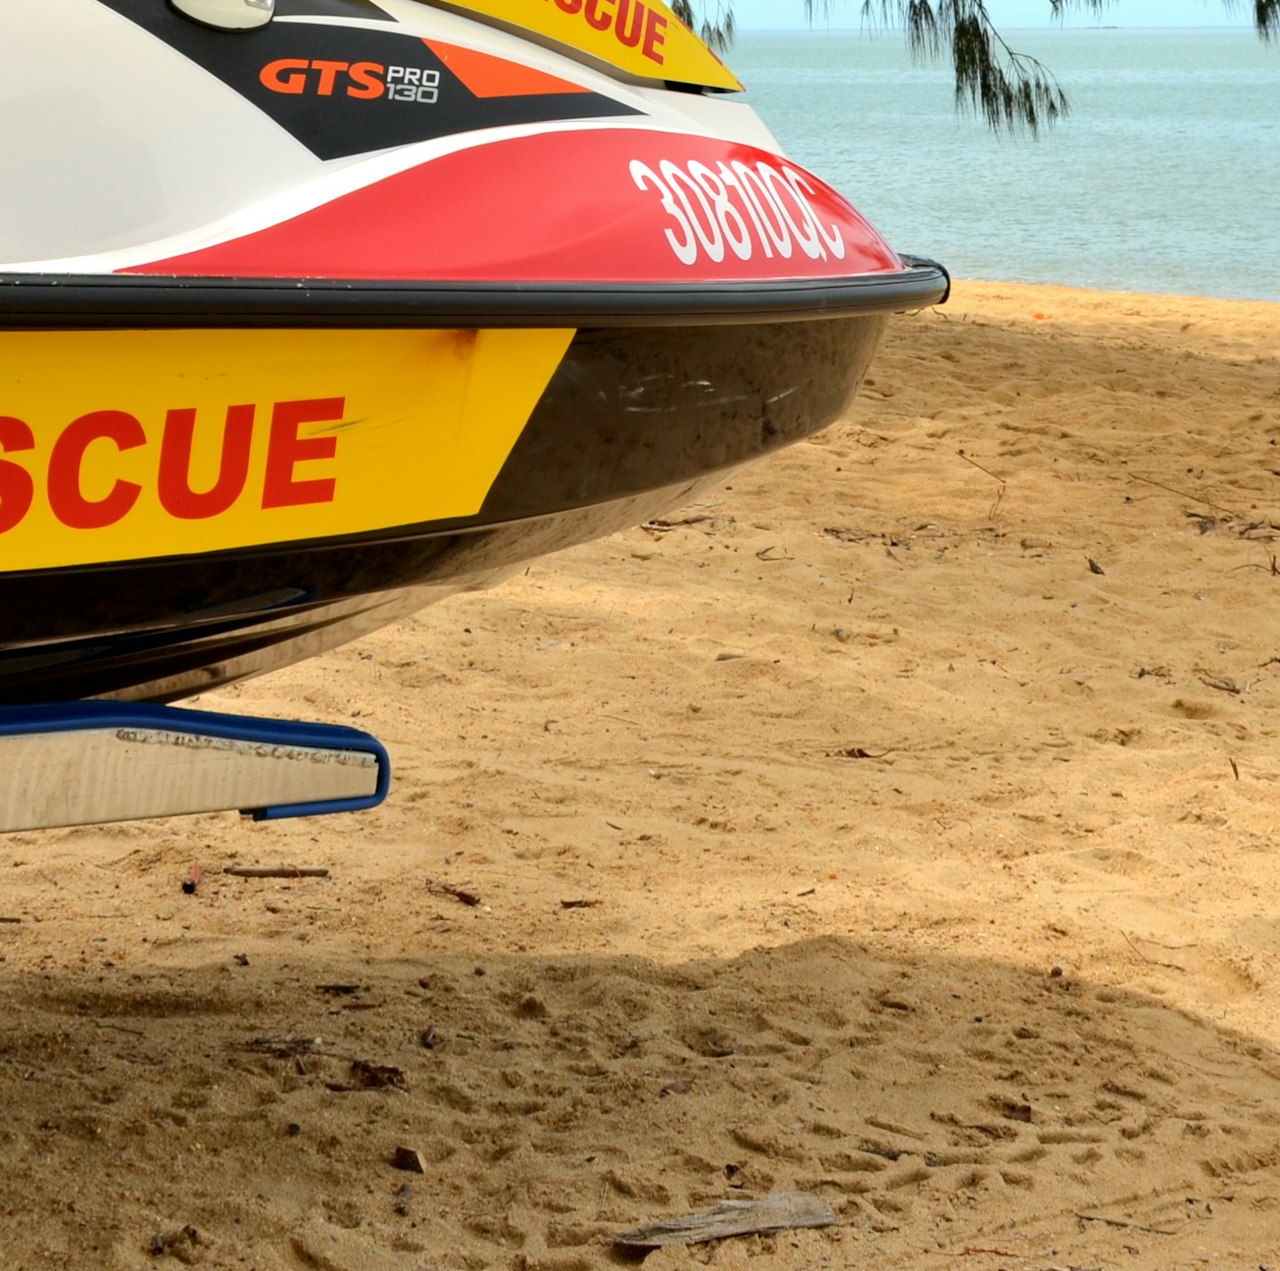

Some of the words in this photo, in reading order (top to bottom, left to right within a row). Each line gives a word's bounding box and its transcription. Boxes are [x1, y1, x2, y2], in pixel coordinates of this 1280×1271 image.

[259, 58, 385, 99] GTS
[386, 65, 441, 88] PRO
[386, 83, 439, 104] 130
[629, 159, 846, 265] 30810QC
